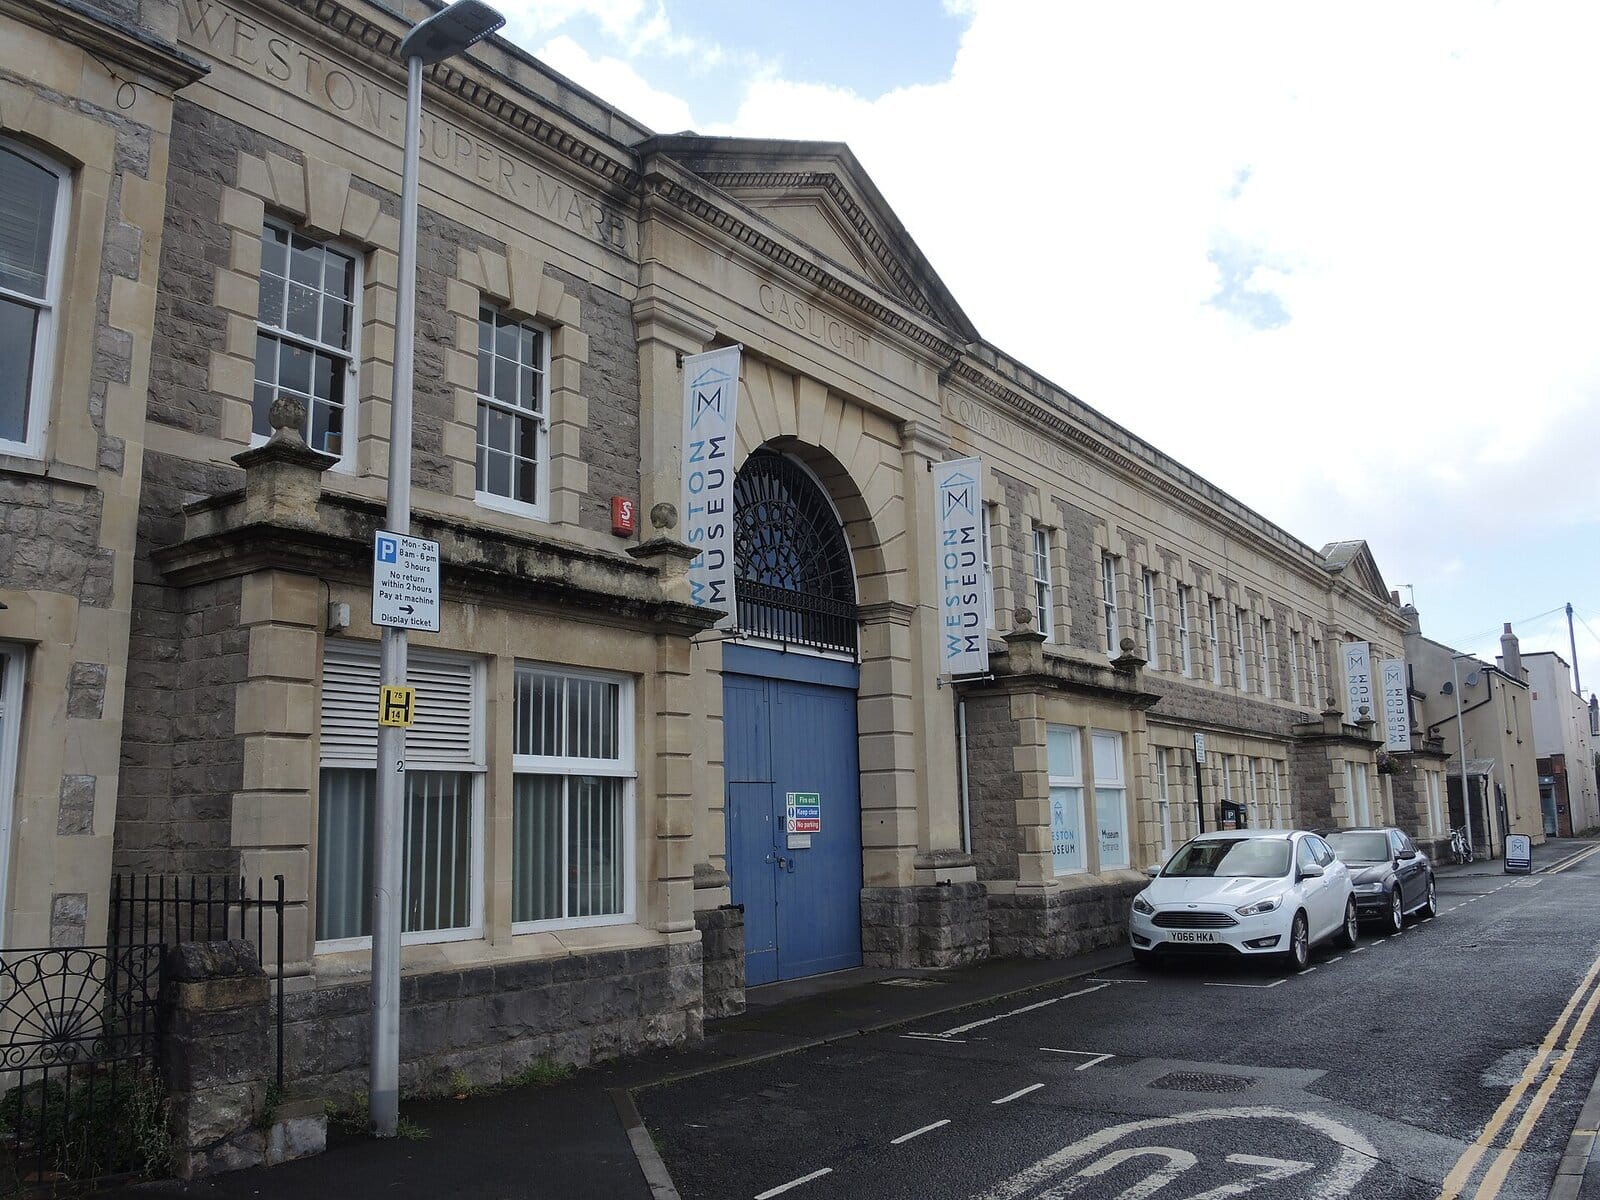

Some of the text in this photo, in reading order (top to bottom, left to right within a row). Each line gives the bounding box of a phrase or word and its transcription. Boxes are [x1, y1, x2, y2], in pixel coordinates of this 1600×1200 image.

[758, 284, 870, 361] GASLIGHT
[945, 393, 1014, 447] COMPANY
[688, 440, 706, 606] WESTON
[707, 436, 726, 603] MUSEUM
[382, 540, 394, 560] P
[401, 539, 417, 549] Mon
[422, 543, 434, 552] Sat
[411, 562, 430, 572] hours
[390, 571, 425, 583] No return
[381, 580, 404, 589] within
[412, 583, 432, 593] hours
[943, 528, 962, 659] WESTON
[960, 526, 979, 652] MUSEUM
[379, 590, 393, 600] Pay
[404, 594, 434, 605] machine
[381, 613, 431, 627] Display ticket
[1349, 675, 1359, 720] STON
[385, 690, 410, 722] H
[391, 710, 401, 719] 14
[1386, 689, 1397, 744] WESTON
[1395, 688, 1407, 743] MUSEUM
[396, 760, 404, 773] 2
[804, 821, 819, 829] parking
[1051, 830, 1074, 841] ESTON
[1051, 843, 1075, 855] USEUM
[1196, 932, 1215, 942] HKA
